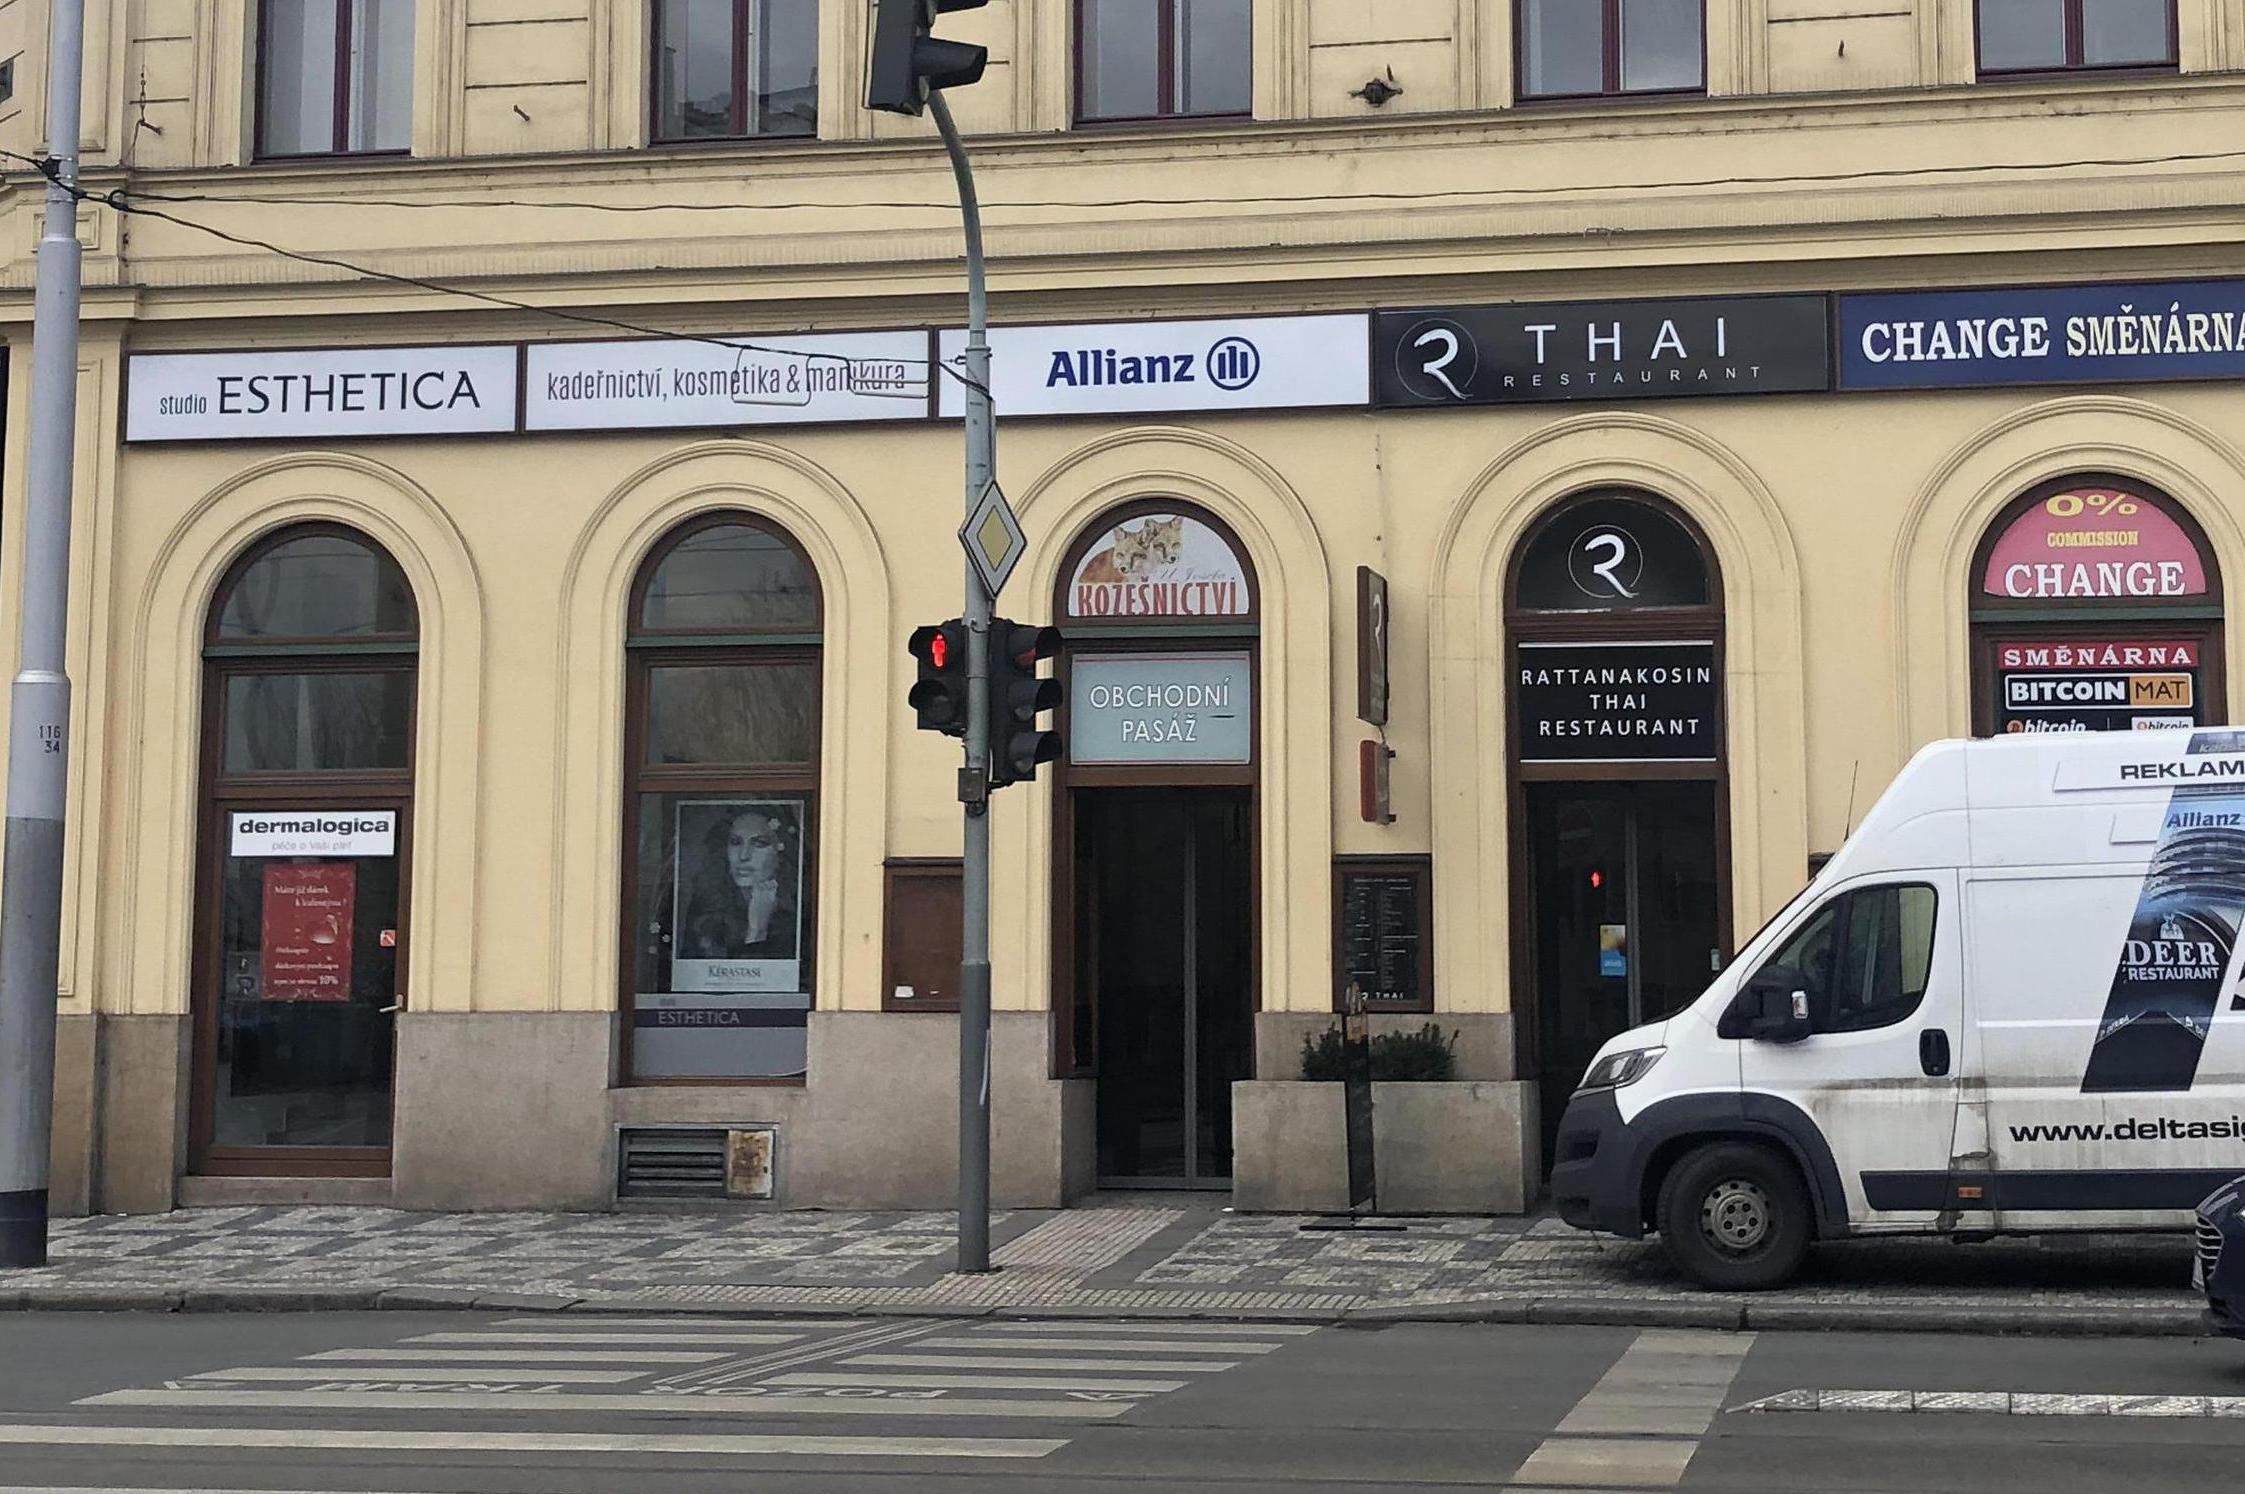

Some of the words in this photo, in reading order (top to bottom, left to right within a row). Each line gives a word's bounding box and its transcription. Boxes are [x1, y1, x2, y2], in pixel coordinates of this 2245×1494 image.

[1524, 317, 1726, 365] THAI
[1861, 317, 2051, 362] CHANGE
[1046, 348, 1195, 387] Allianz
[1504, 366, 1761, 388] RESTAURANT
[160, 392, 208, 415] studio
[217, 370, 481, 414] ESTHETICA
[547, 367, 667, 402] kadeřnictví,
[674, 363, 780, 396] kosmetika
[786, 369, 800, 394] &
[2046, 493, 2138, 517] 0%
[2047, 531, 2139, 547] COMMISSION
[2004, 561, 2185, 598] CHANGE
[2004, 644, 2192, 667] SMĚNÁRNA
[1521, 667, 1711, 686] RATTANAKOSIN
[1090, 675, 1232, 708] OBCHODNÍ
[1589, 694, 1647, 710] THAI
[2010, 680, 2126, 702] BITCOIN
[2135, 681, 2186, 700] MAT
[39, 725, 61, 739] 116
[1122, 713, 1197, 742] PASÁŽ
[1539, 718, 1700, 736] RESTAURANT
[44, 740, 60, 754] 34
[239, 818, 389, 836] dermalogica
[2166, 812, 2241, 828] Allianz
[2126, 940, 2220, 966] DEER
[2128, 967, 2220, 980] RESTAURANT
[658, 1011, 741, 1025] ESTHETICA
[2009, 1114, 2245, 1142] www.deltasi
